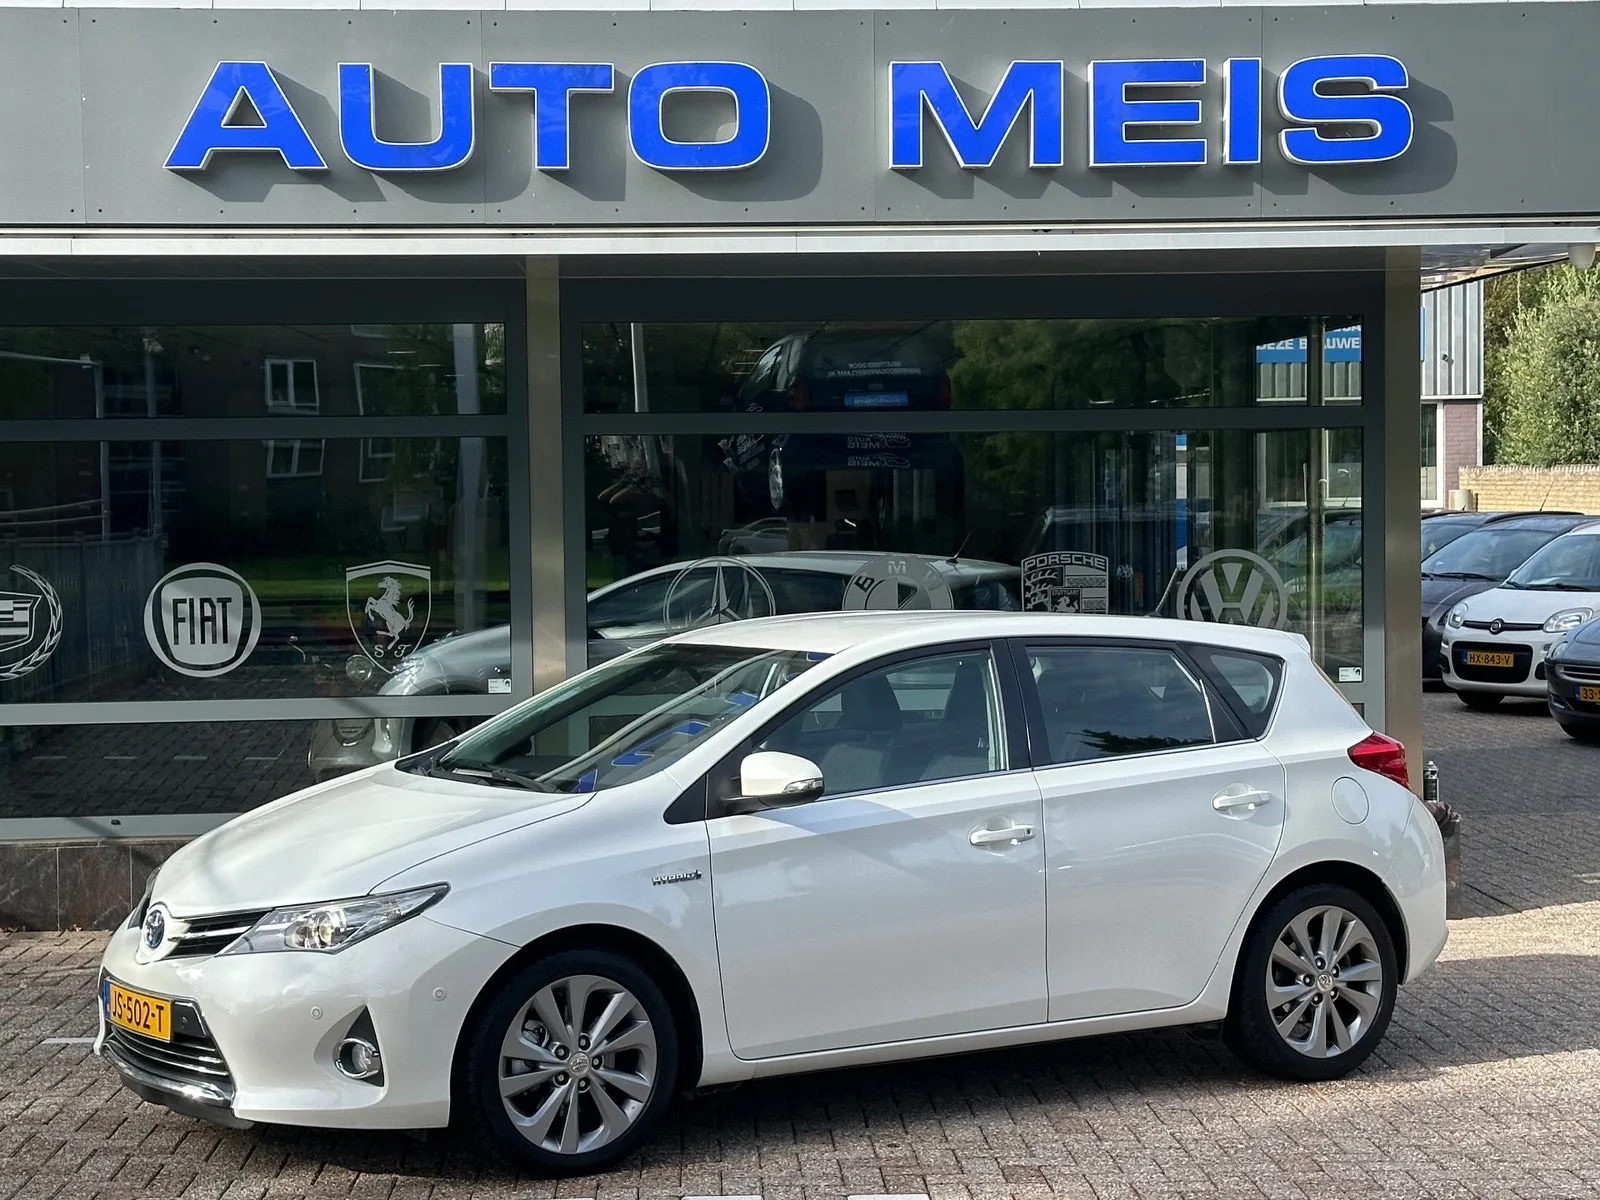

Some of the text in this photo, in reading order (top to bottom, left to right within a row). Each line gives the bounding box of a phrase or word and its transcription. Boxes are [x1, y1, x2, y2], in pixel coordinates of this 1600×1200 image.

[163, 53, 1415, 171] AUTO MEIS
[1299, 337, 1360, 350] BUWE
[1024, 554, 1106, 571] PORSCHE
[172, 597, 232, 645] FIAT
[1469, 651, 1511, 665] HX-843-V
[112, 990, 165, 1033] JS-502-T
